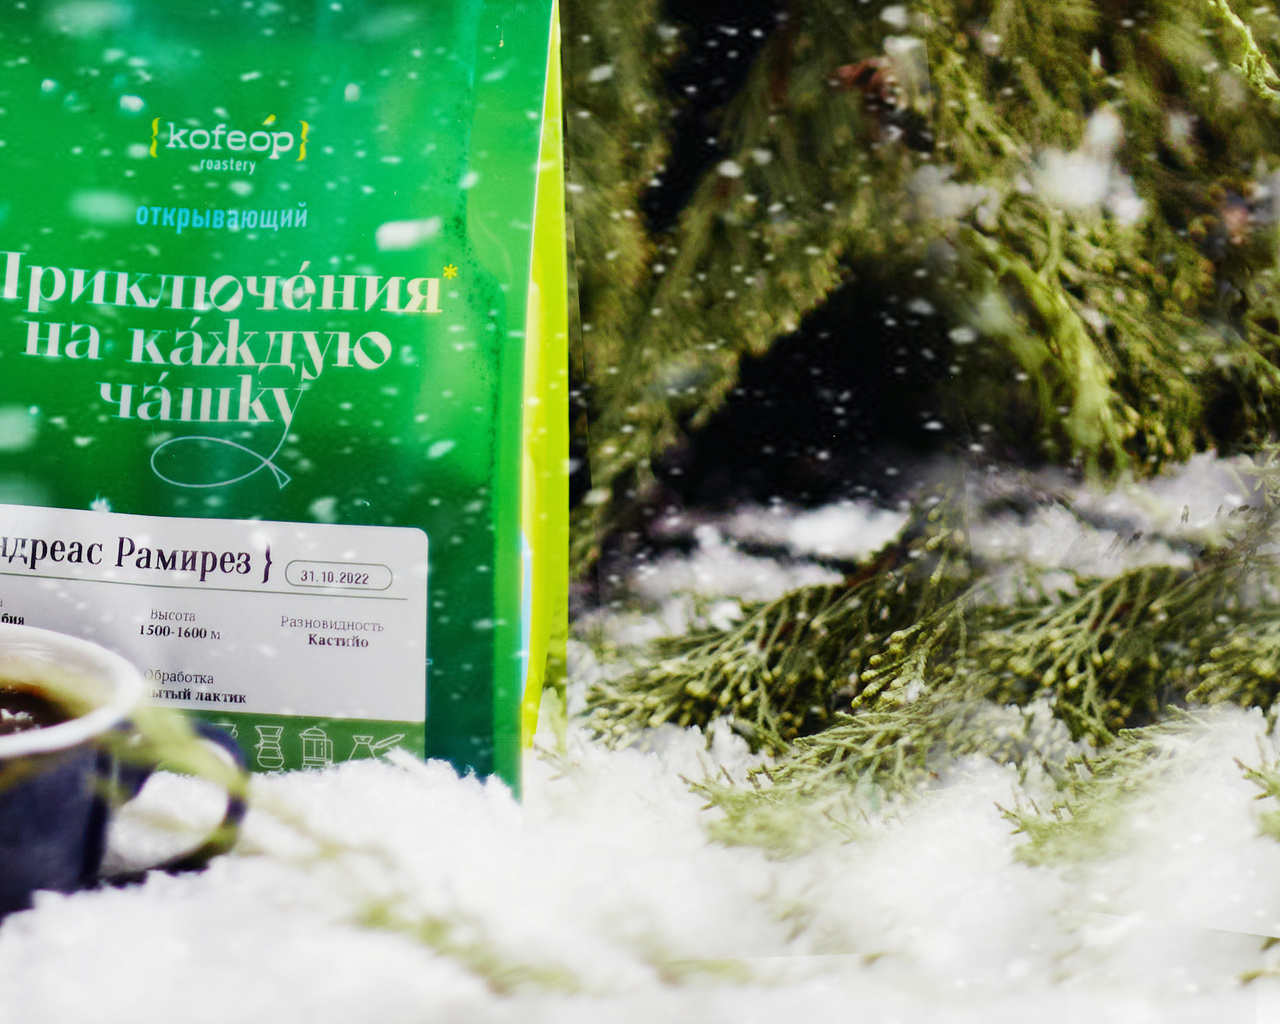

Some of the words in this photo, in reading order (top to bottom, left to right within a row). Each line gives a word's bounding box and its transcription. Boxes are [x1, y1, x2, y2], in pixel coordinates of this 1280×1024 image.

[200, 158, 256, 175] roastery
[136, 202, 308, 234] открывающий
[21, 321, 103, 360] на
[115, 536, 251, 582] Рамирез
[300, 569, 369, 585] 31.10.2022
[140, 624, 207, 639] 1500-1600
[281, 615, 384, 632] Разновидность
[308, 634, 369, 648] Кастийо
[144, 668, 214, 684] Обработка
[147, 687, 191, 700] ытый
[195, 690, 247, 704] лактик
